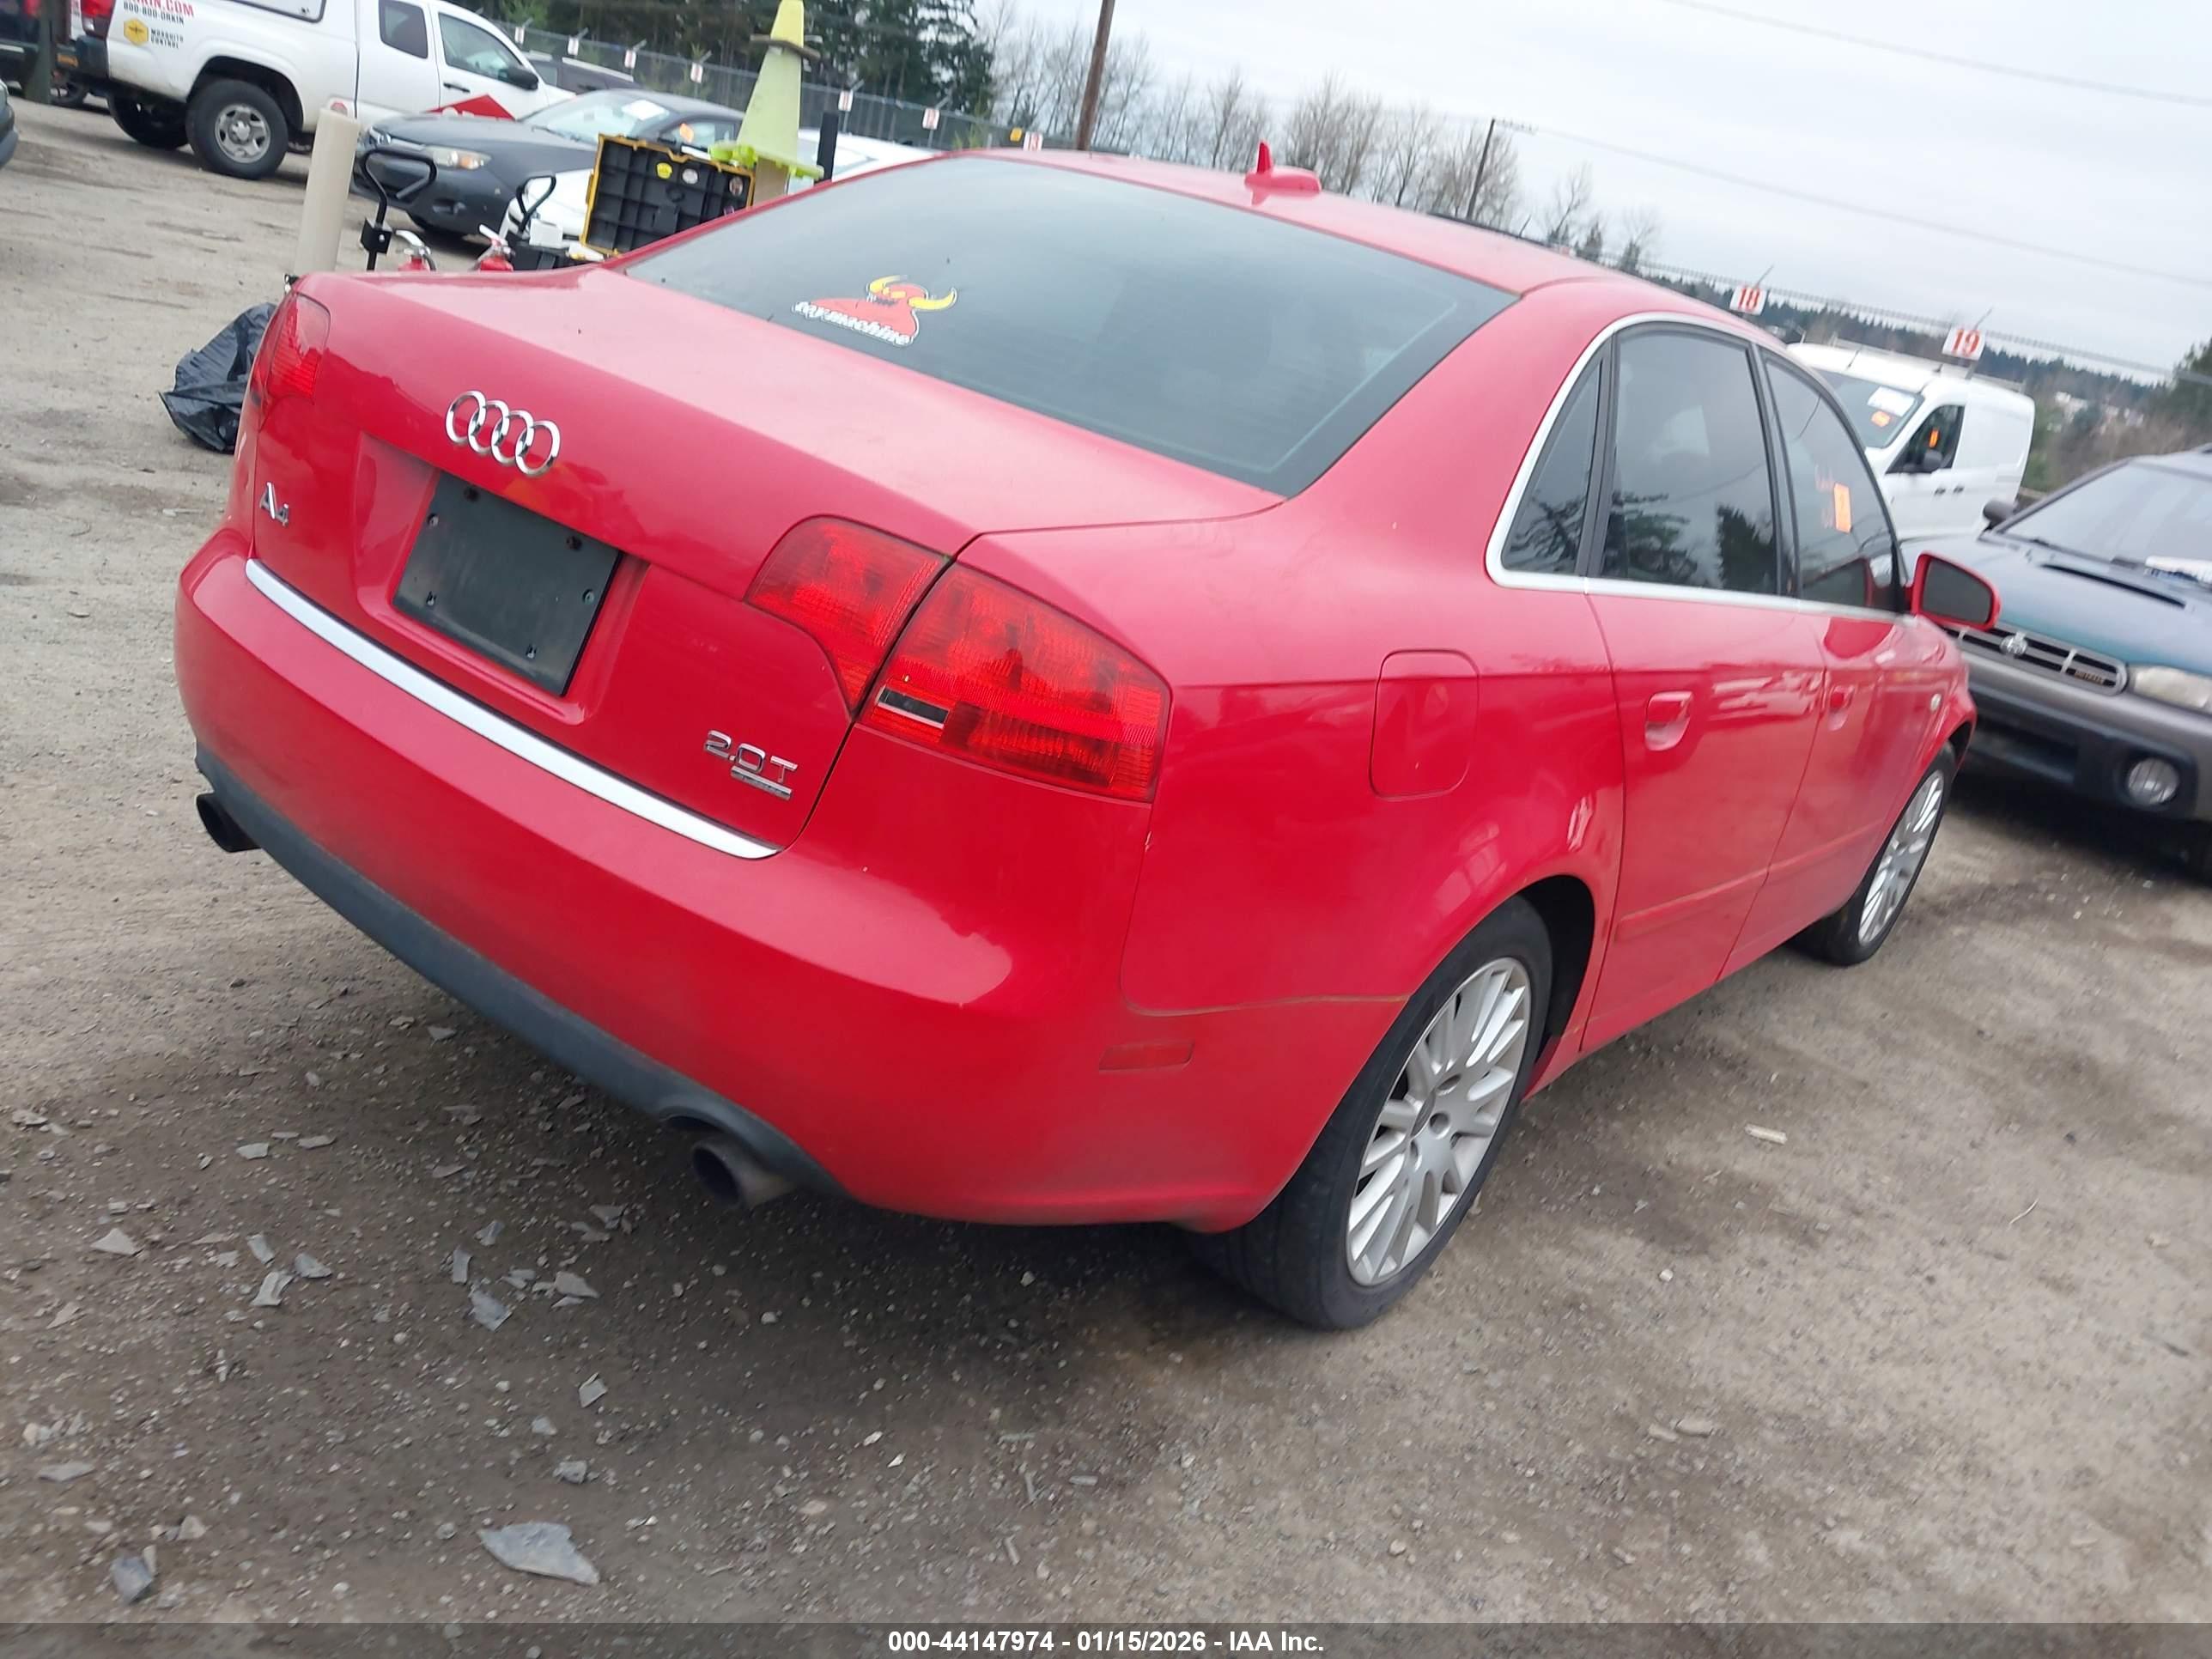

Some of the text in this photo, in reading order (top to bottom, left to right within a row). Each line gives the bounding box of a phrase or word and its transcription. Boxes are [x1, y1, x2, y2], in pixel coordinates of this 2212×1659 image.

[1737, 287, 1759, 311] 18
[1950, 329, 1980, 357] 19
[258, 481, 289, 526] A4
[704, 729, 799, 783] 2.0T
